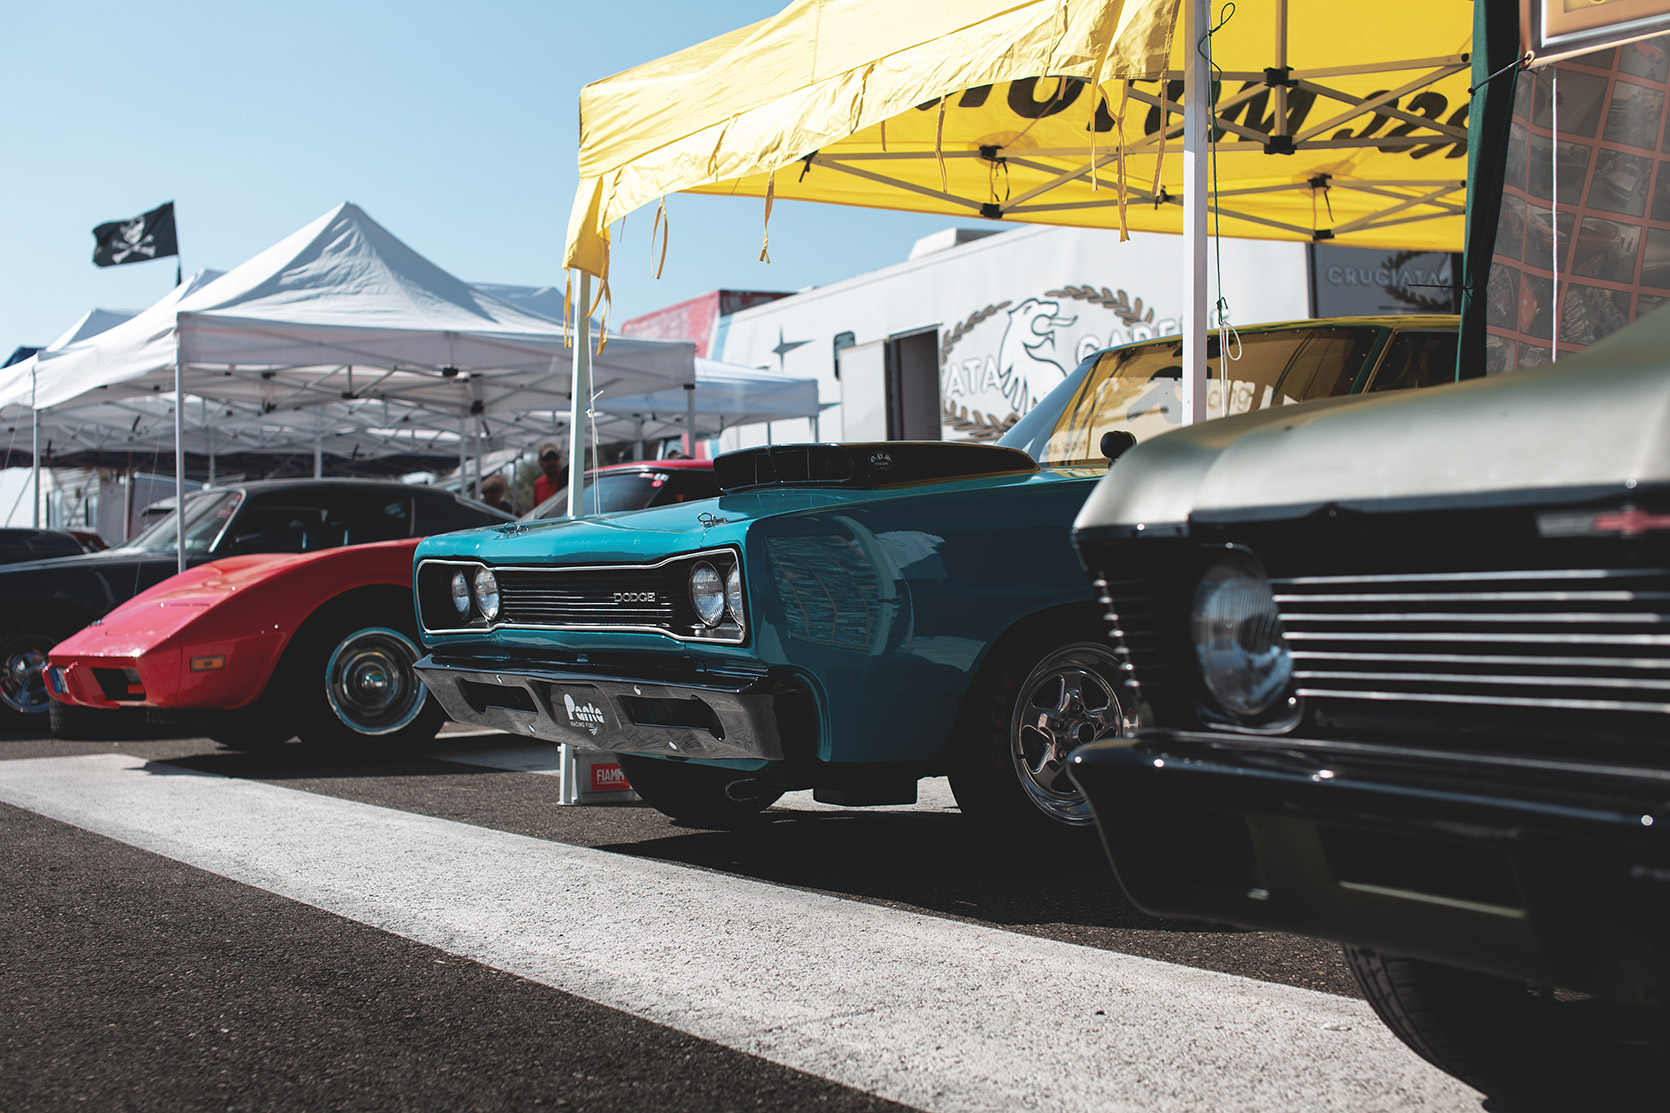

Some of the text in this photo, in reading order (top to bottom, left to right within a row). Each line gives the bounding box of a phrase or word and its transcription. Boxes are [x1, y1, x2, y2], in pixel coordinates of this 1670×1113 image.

[1327, 265, 1441, 287] CRUCIATA
[942, 354, 1000, 397] ATA
[613, 592, 656, 602] DODGE
[563, 693, 605, 723] Panta
